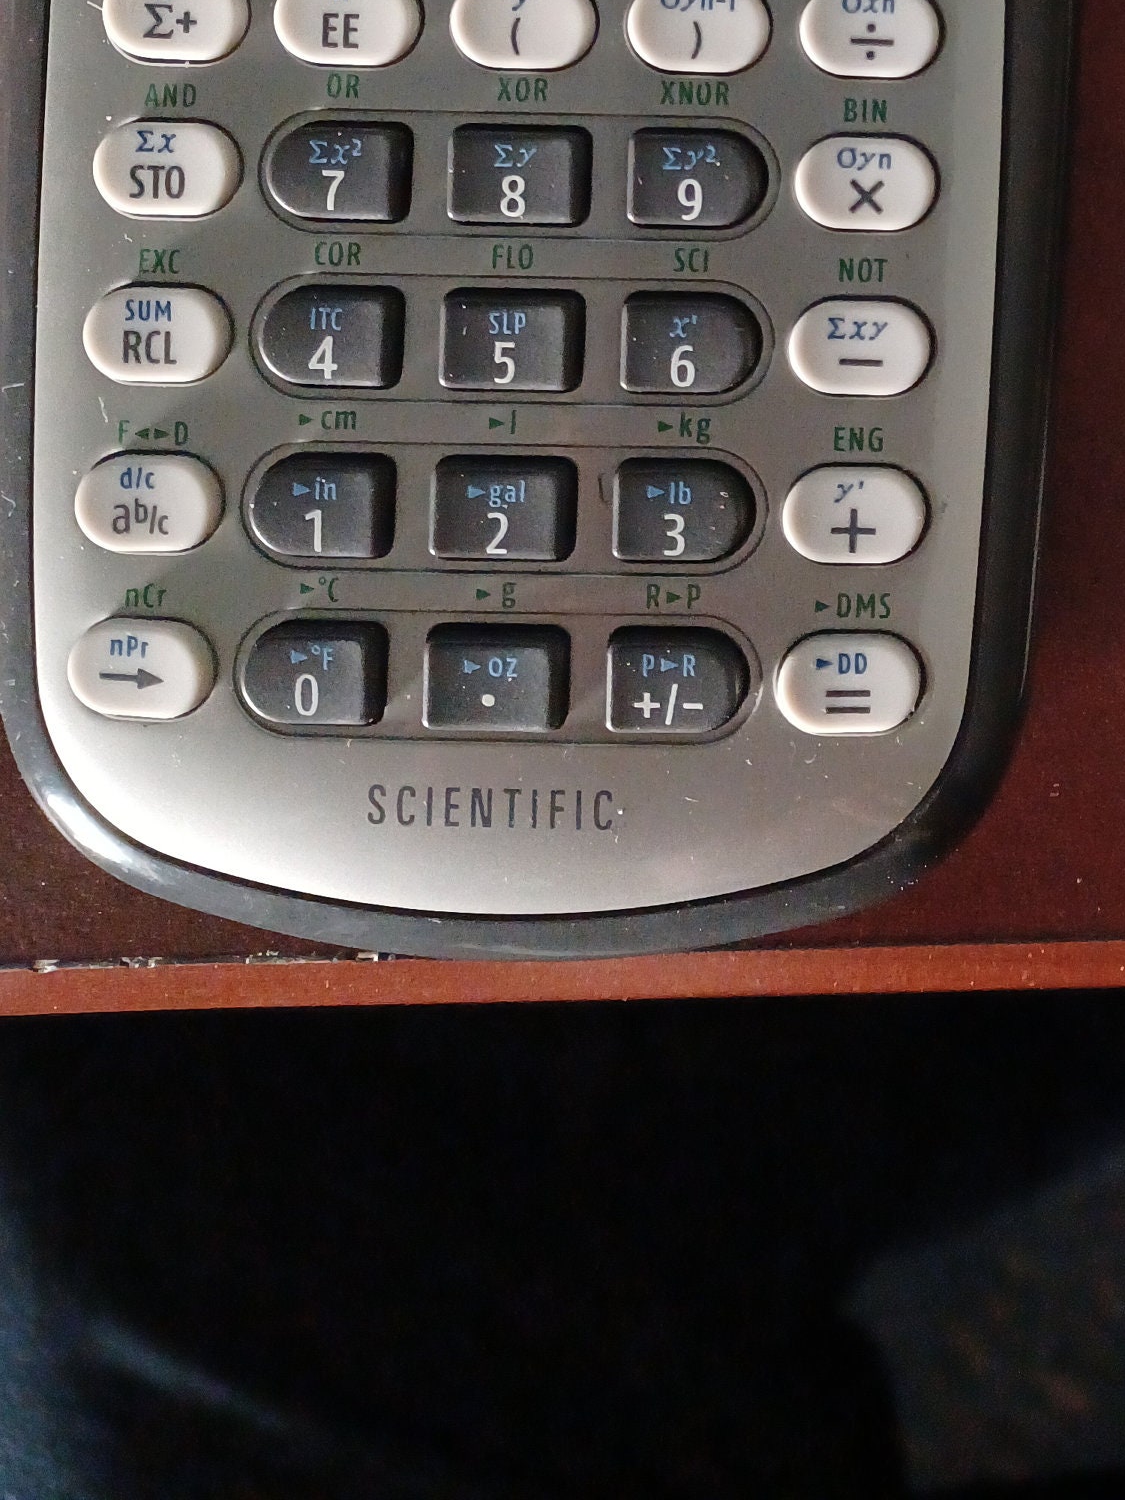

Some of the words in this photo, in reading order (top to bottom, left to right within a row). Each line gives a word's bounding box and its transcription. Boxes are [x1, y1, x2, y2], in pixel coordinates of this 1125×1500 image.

[322, 14, 359, 48] EE
[145, 82, 196, 108] AND
[327, 75, 359, 99] OR
[498, 78, 549, 102] XOR
[660, 81, 729, 105] XNOR
[843, 100, 888, 124] BIN
[130, 166, 185, 199] STO
[322, 171, 345, 210] 7
[501, 176, 524, 218] 8
[677, 179, 701, 219] 9
[138, 249, 180, 274] EXC
[315, 243, 360, 267] COR
[492, 245, 534, 270] FLO
[674, 249, 709, 273] SCI
[839, 259, 888, 283] NOT
[124, 300, 171, 323] SUM
[309, 309, 342, 332] ITC
[488, 313, 526, 336] SLP
[122, 329, 176, 365] RCL
[308, 339, 337, 379] 4
[493, 343, 515, 383] 5
[670, 346, 694, 386] 6
[322, 410, 356, 430] cm
[680, 413, 710, 442] kg
[833, 427, 883, 452] ENG
[489, 481, 525, 509] gal
[669, 481, 691, 504] lb
[304, 511, 323, 552] 1
[486, 514, 508, 554] 2
[664, 515, 685, 555] 3
[125, 585, 165, 609] nCr
[837, 594, 891, 619] DMS
[110, 636, 148, 659] nPr
[838, 652, 868, 676] DD
[296, 675, 318, 715] 0
[634, 685, 703, 725] +/-
[367, 785, 612, 830] SCIENTIFIC
